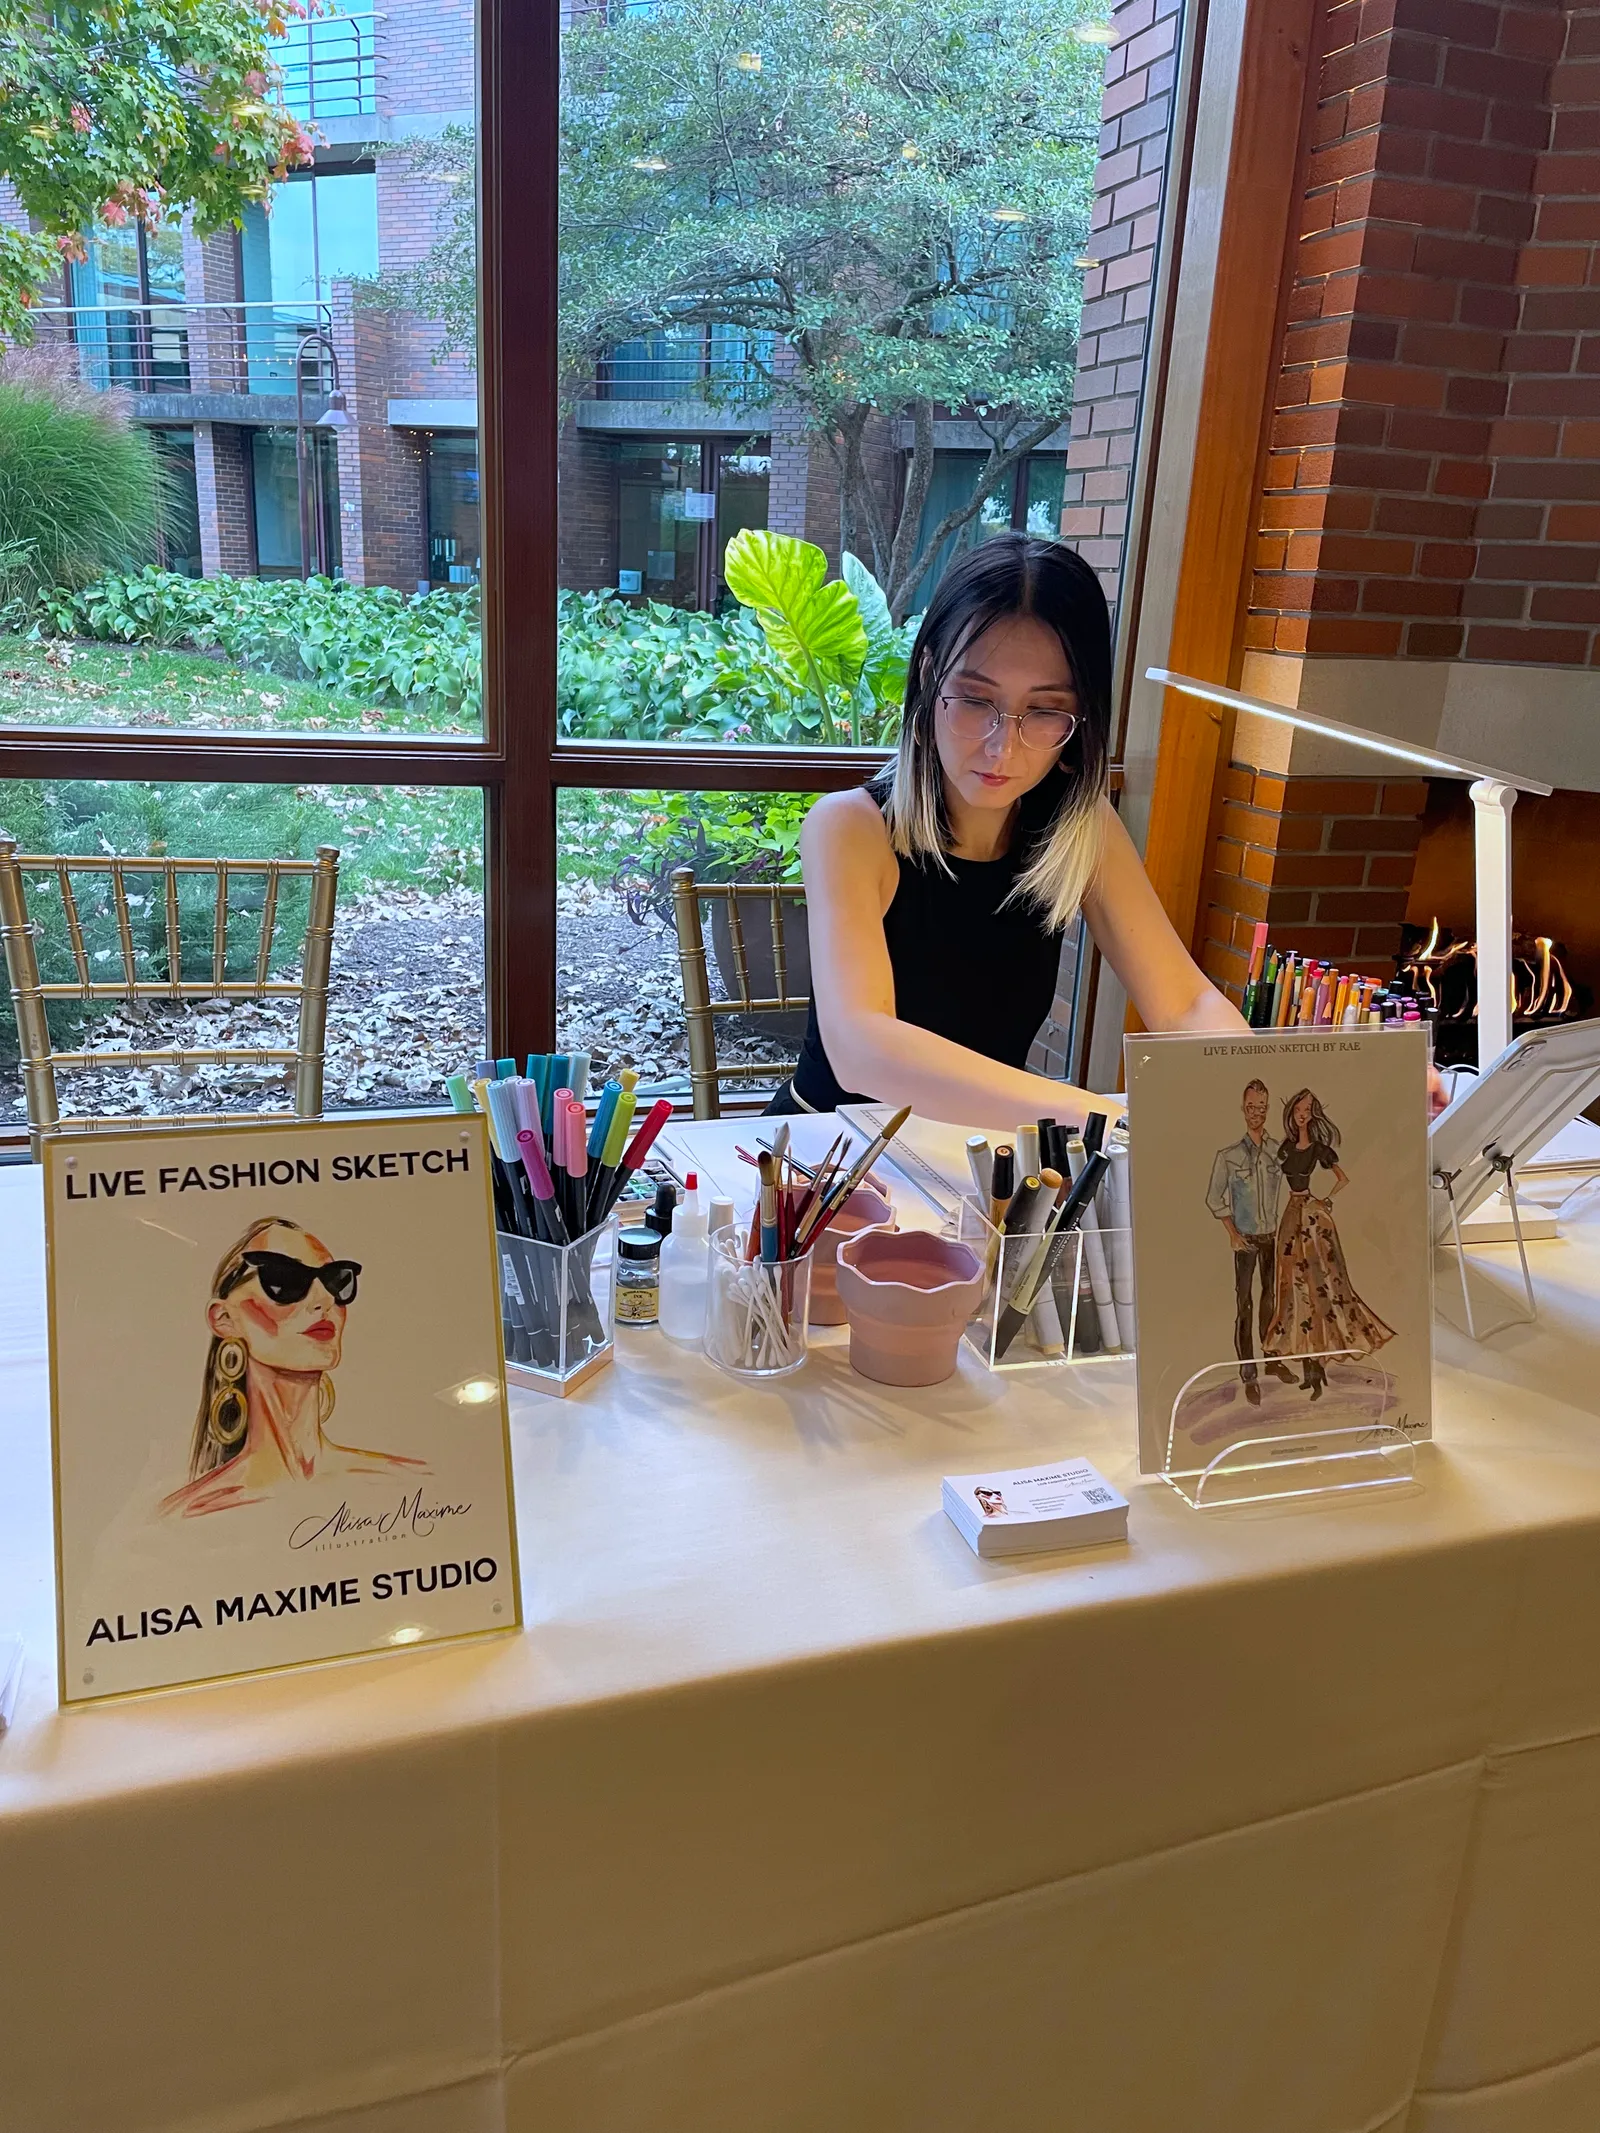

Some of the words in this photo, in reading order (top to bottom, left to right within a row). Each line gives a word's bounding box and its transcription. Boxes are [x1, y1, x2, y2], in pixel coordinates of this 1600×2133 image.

[1203, 1046, 1228, 1056] LIVE
[1230, 1044, 1276, 1055] FASHION
[1279, 1043, 1320, 1053] SKETCH
[1323, 1042, 1336, 1051] BY
[1339, 1041, 1361, 1051] RAE
[66, 1169, 146, 1200] LIVE
[159, 1157, 320, 1194] FASHION
[331, 1147, 470, 1181] SKETCH
[1033, 1474, 1062, 1482] MAXIME
[1062, 1468, 1089, 1478] STUDIO
[289, 1501, 384, 1550] Alisa
[378, 1487, 472, 1537] Maxime
[315, 1533, 407, 1551] illustration
[86, 1604, 203, 1647] ALISA
[215, 1577, 361, 1625] MAXIME
[371, 1556, 499, 1600] STUDIO
